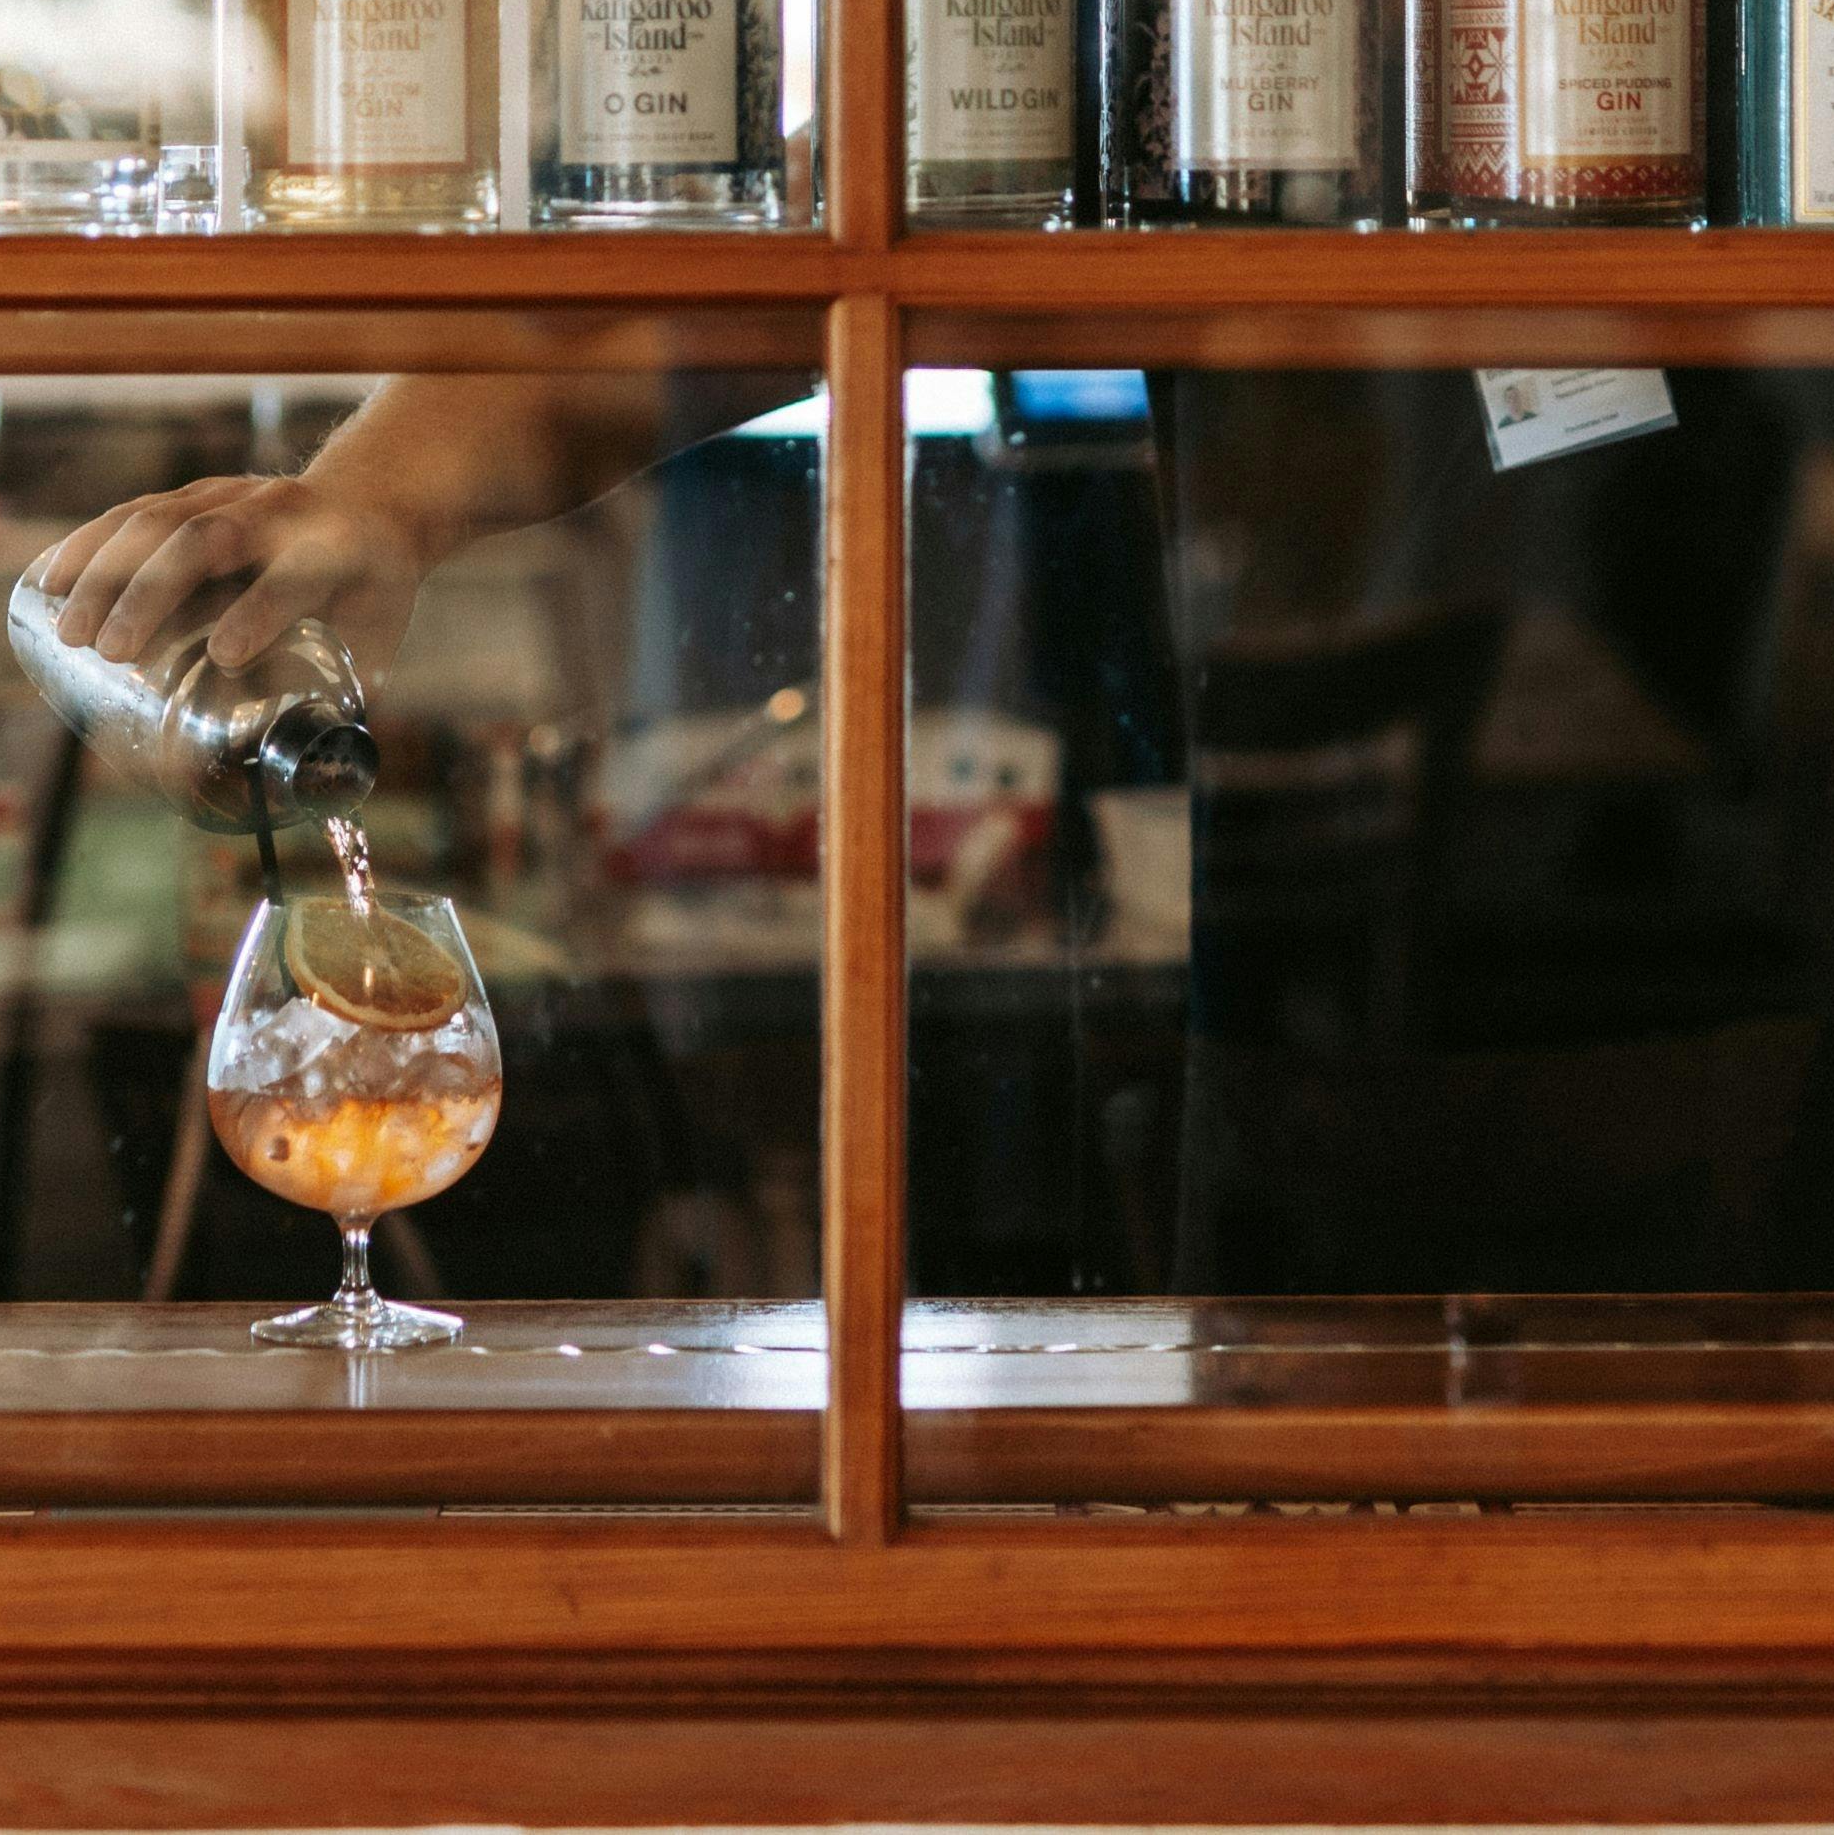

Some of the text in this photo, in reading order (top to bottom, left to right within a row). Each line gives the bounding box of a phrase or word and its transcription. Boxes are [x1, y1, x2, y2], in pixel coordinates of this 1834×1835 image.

[342, 21, 420, 51] sland
[604, 21, 688, 51] Island
[973, 18, 1046, 48] Island
[1230, 18, 1313, 47] Island
[1576, 16, 1658, 46] Island
[1220, 76, 1320, 91] MULBERRY
[1558, 77, 1673, 90] SPICED PUDDING
[603, 92, 689, 115] O GIN
[950, 86, 1060, 111] WILD GIN
[1247, 92, 1295, 112] GIN
[1596, 91, 1643, 112] GIN
